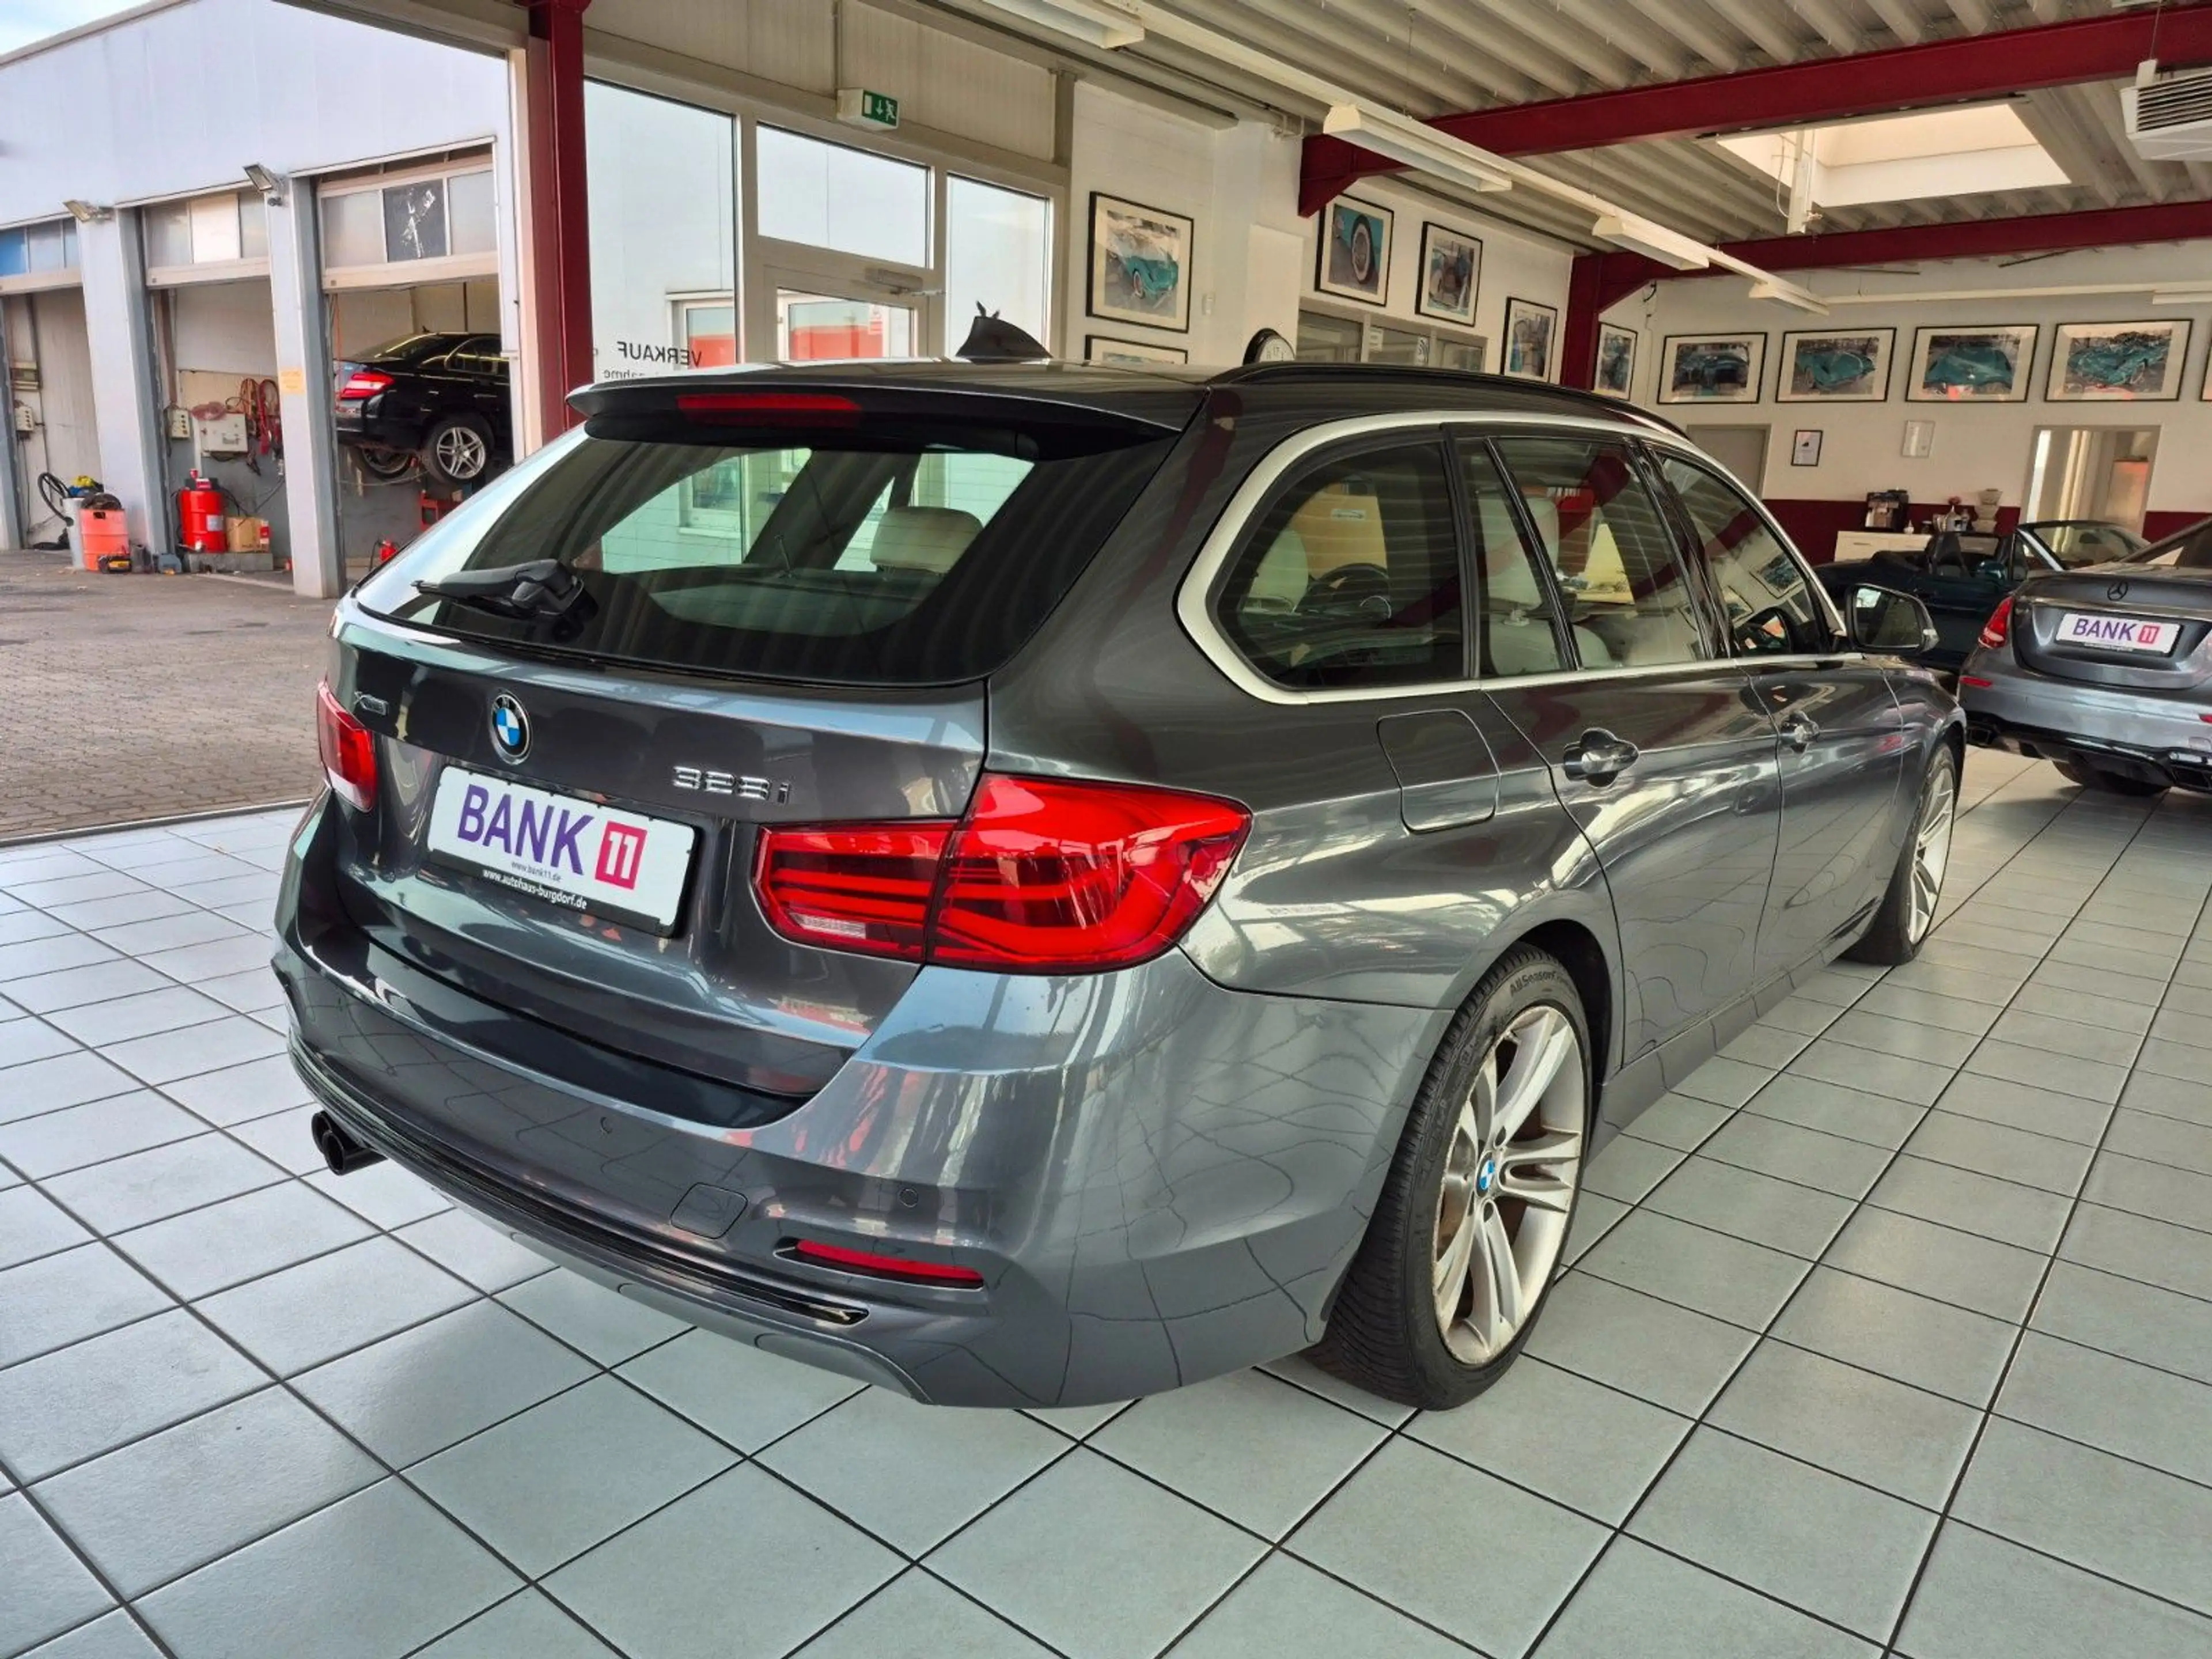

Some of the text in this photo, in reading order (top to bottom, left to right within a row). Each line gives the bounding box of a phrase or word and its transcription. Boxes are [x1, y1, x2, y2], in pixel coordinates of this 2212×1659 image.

[2073, 618, 2157, 643] BANK 11
[672, 766, 791, 804] 328i
[457, 783, 641, 881] BANK 11
[483, 869, 588, 910] www.autohaus-burgdorf.de
[512, 862, 562, 882] www.bank11.de
